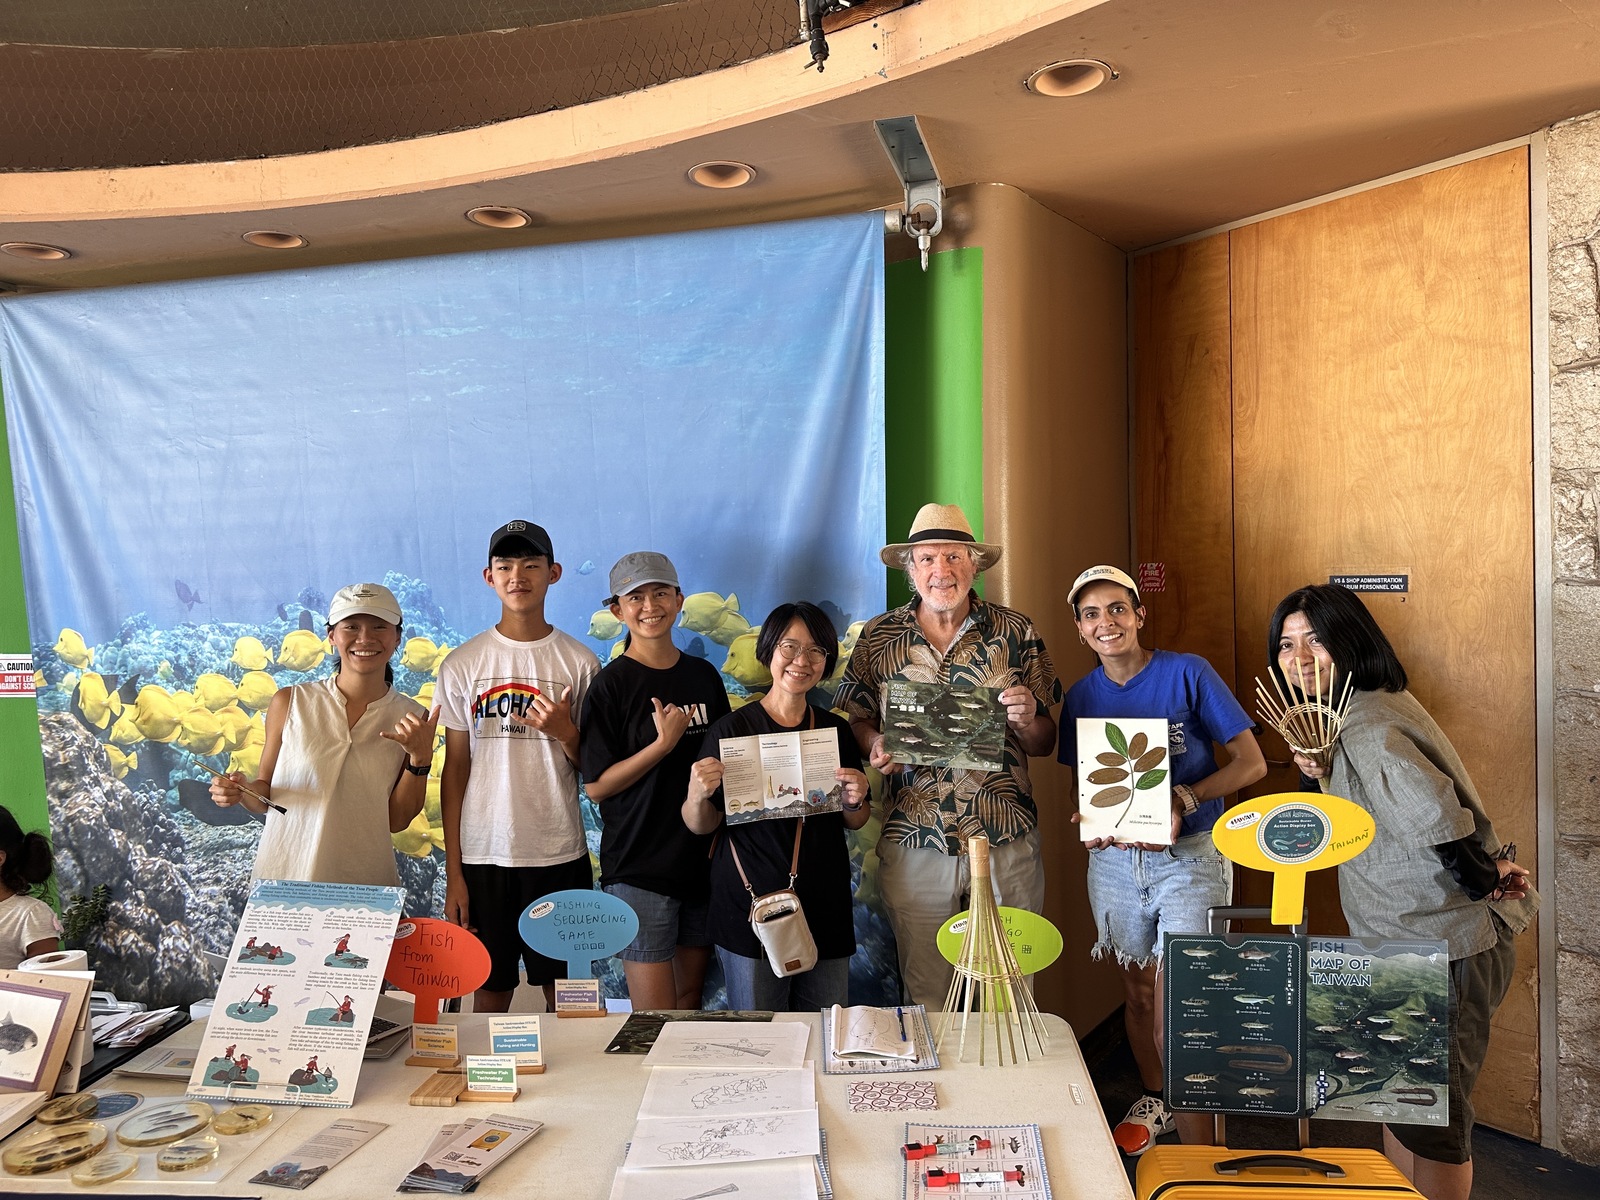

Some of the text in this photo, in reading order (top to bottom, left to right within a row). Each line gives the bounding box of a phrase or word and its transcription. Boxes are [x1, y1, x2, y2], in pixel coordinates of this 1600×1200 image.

[501, 725, 526, 734] HAWAII
[557, 901, 600, 909] FISHING
[554, 914, 627, 926] SEQUENCING
[420, 923, 453, 950] Fish
[558, 931, 595, 941] GAME
[1310, 942, 1344, 953] FISH
[400, 946, 433, 962] from
[1310, 957, 1371, 970] MAP OF
[406, 966, 459, 992] Taiwan
[1309, 972, 1372, 987] TAIWAN
